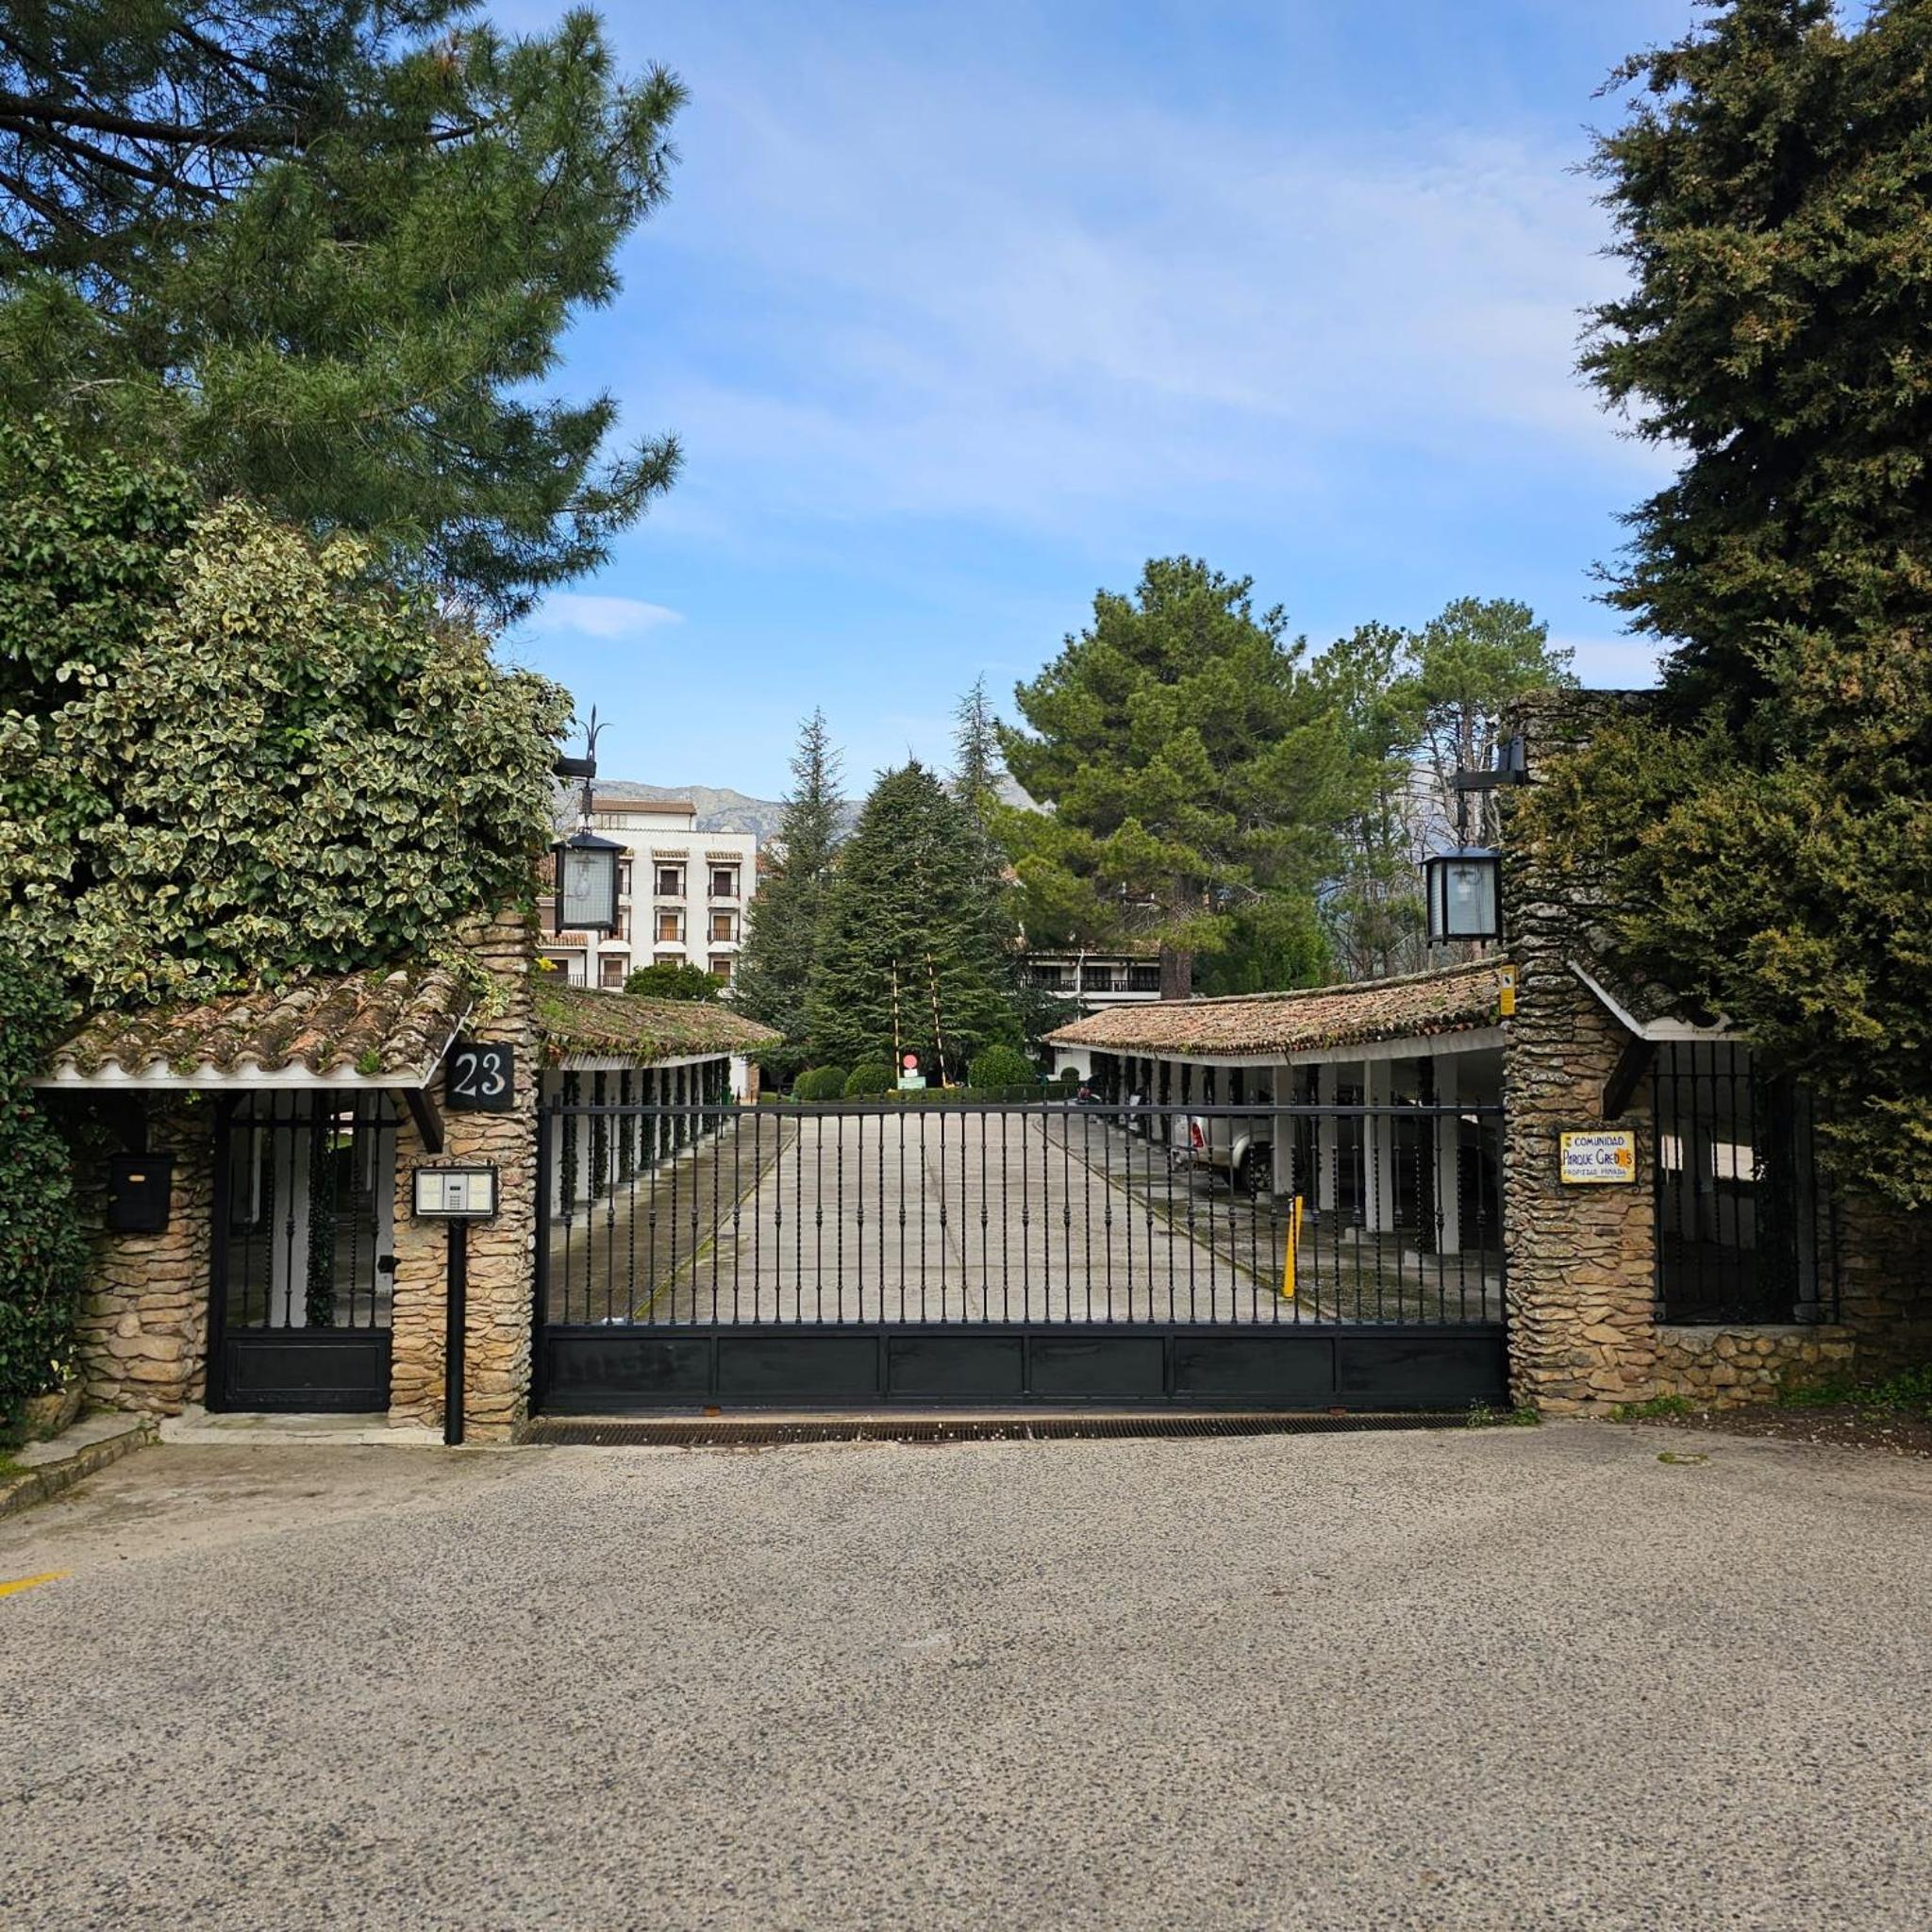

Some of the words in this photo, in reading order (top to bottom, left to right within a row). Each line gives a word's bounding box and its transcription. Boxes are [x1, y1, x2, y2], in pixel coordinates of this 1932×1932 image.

[454, 1053, 506, 1097] 23
[1574, 1136, 1624, 1147] COMUNIDAD
[1562, 1149, 1593, 1166] PARQUE
[1596, 1148, 1633, 1166] GREDS
